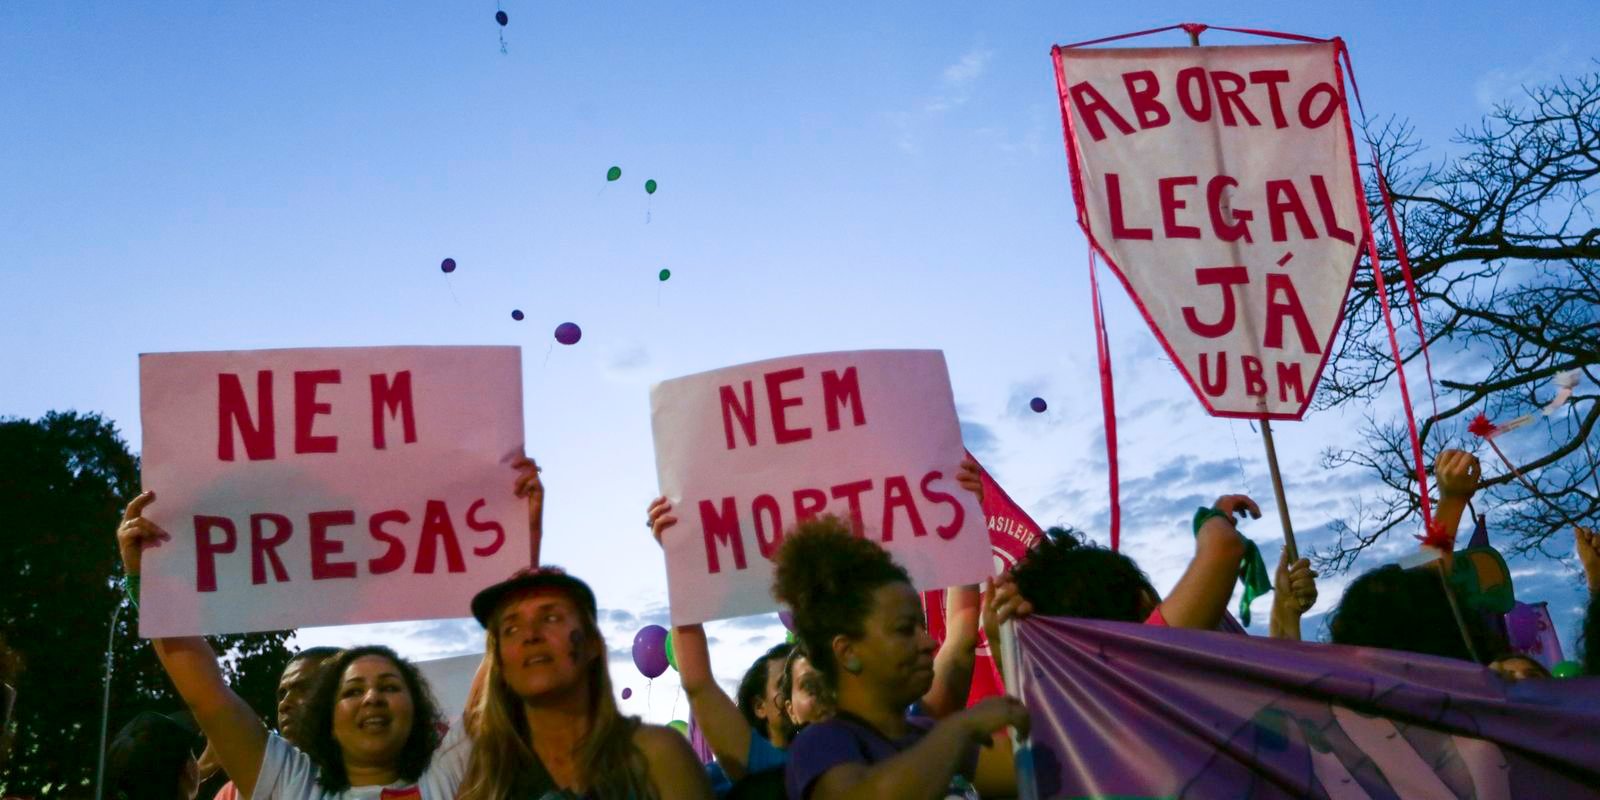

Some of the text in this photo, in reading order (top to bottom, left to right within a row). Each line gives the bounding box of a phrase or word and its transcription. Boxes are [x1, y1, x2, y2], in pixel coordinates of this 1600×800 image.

[1069, 66, 1341, 142] ABORTO
[1104, 173, 1356, 246] LEGAL
[1181, 251, 1322, 355] JÁ
[218, 369, 417, 461] NEM
[719, 366, 867, 450] NEM
[1199, 352, 1305, 403] UBM
[193, 498, 506, 592] PRESAS
[987, 515, 1041, 550] ASILEIR
